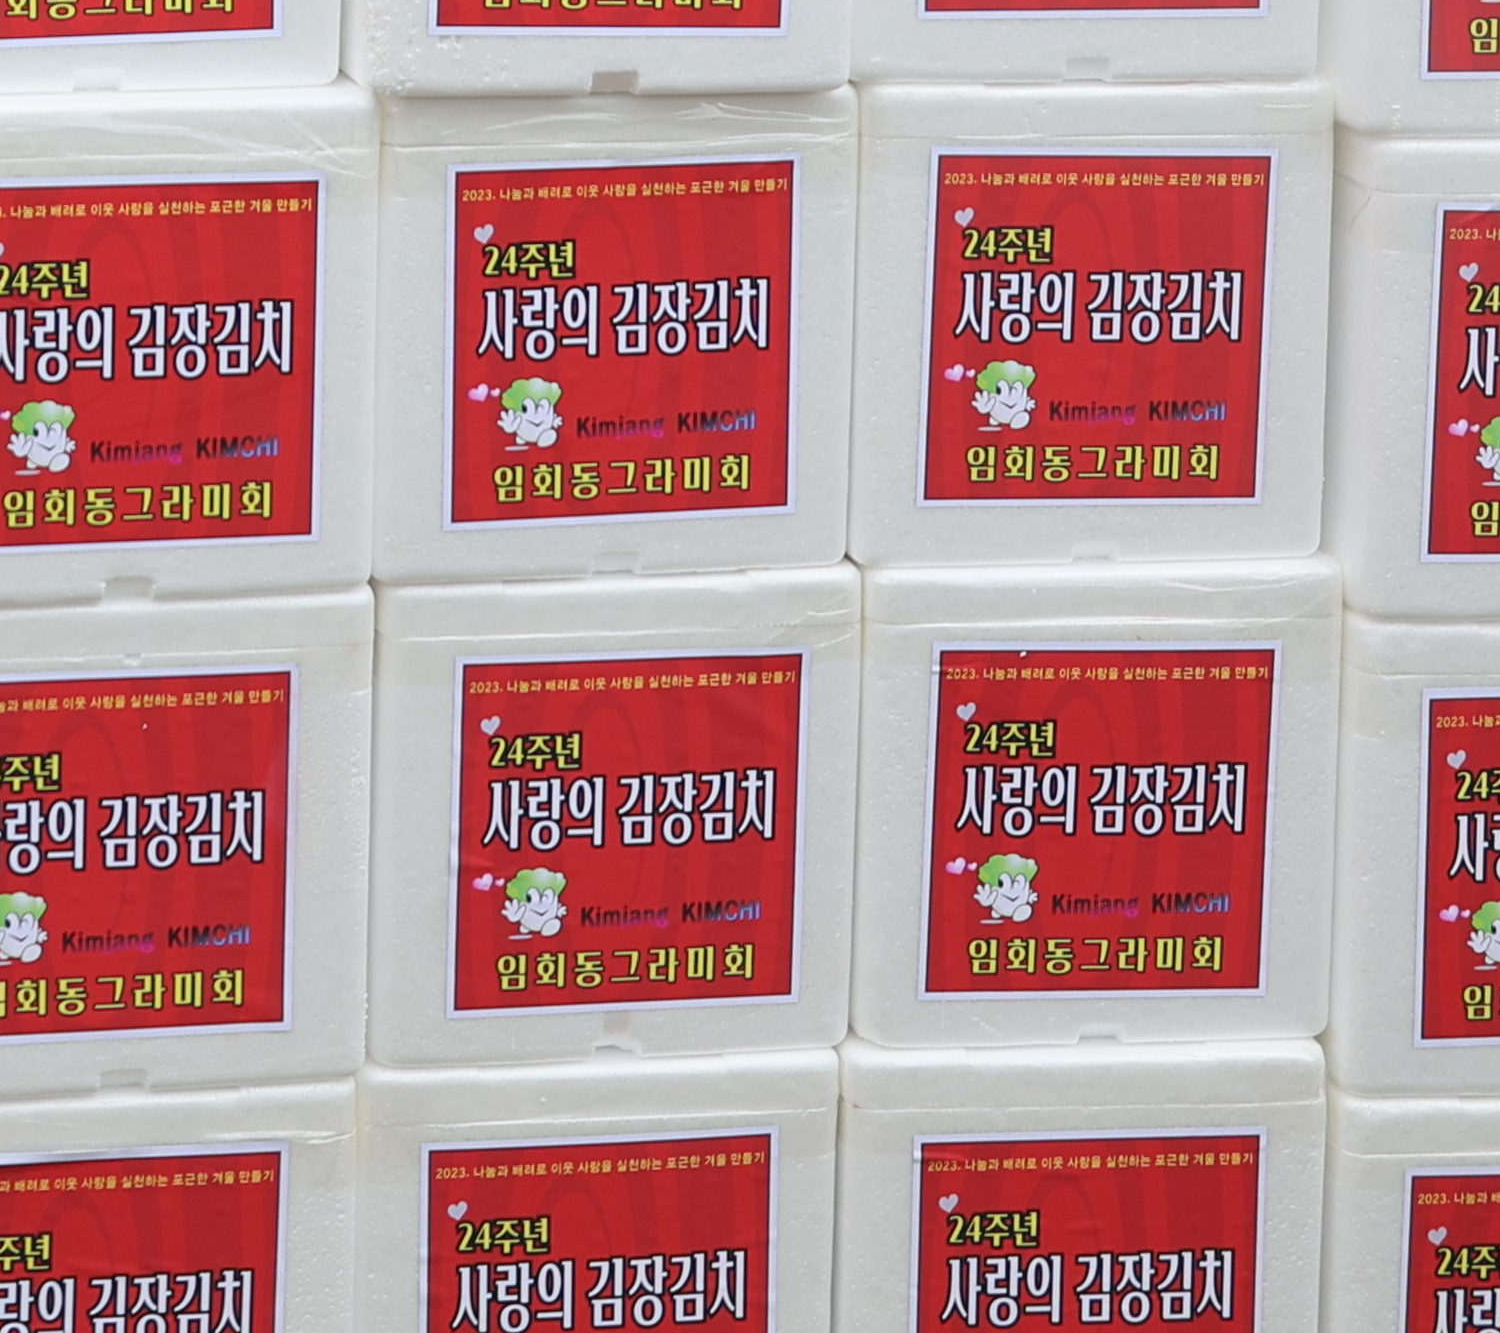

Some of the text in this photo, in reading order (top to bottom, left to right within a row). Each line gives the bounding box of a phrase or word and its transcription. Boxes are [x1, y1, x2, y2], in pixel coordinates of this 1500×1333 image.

[944, 172, 1265, 187] 2023. 나눔과 배려로 이웃 사랑을 실천하는 포근한 겨울 만들기
[963, 227, 1053, 264] 24주년
[954, 269, 1243, 344] 사랑의 김장김치
[127, 299, 293, 379] 김장김치
[1147, 400, 1226, 423] KIMCHI
[195, 436, 278, 460] KIMCHI
[966, 444, 1220, 483] 임회동그라미회
[2, 481, 272, 529] 임회동그라미회
[490, 733, 581, 770] 24주년
[99, 789, 264, 869] 김장김치
[482, 768, 775, 851] 사랑의 김장김치
[681, 899, 761, 923] KIMCHI
[496, 943, 754, 992] 임회동그라미회
[457, 1216, 549, 1255] 24주년
[451, 1249, 746, 1333] 사랑의 김장김치
